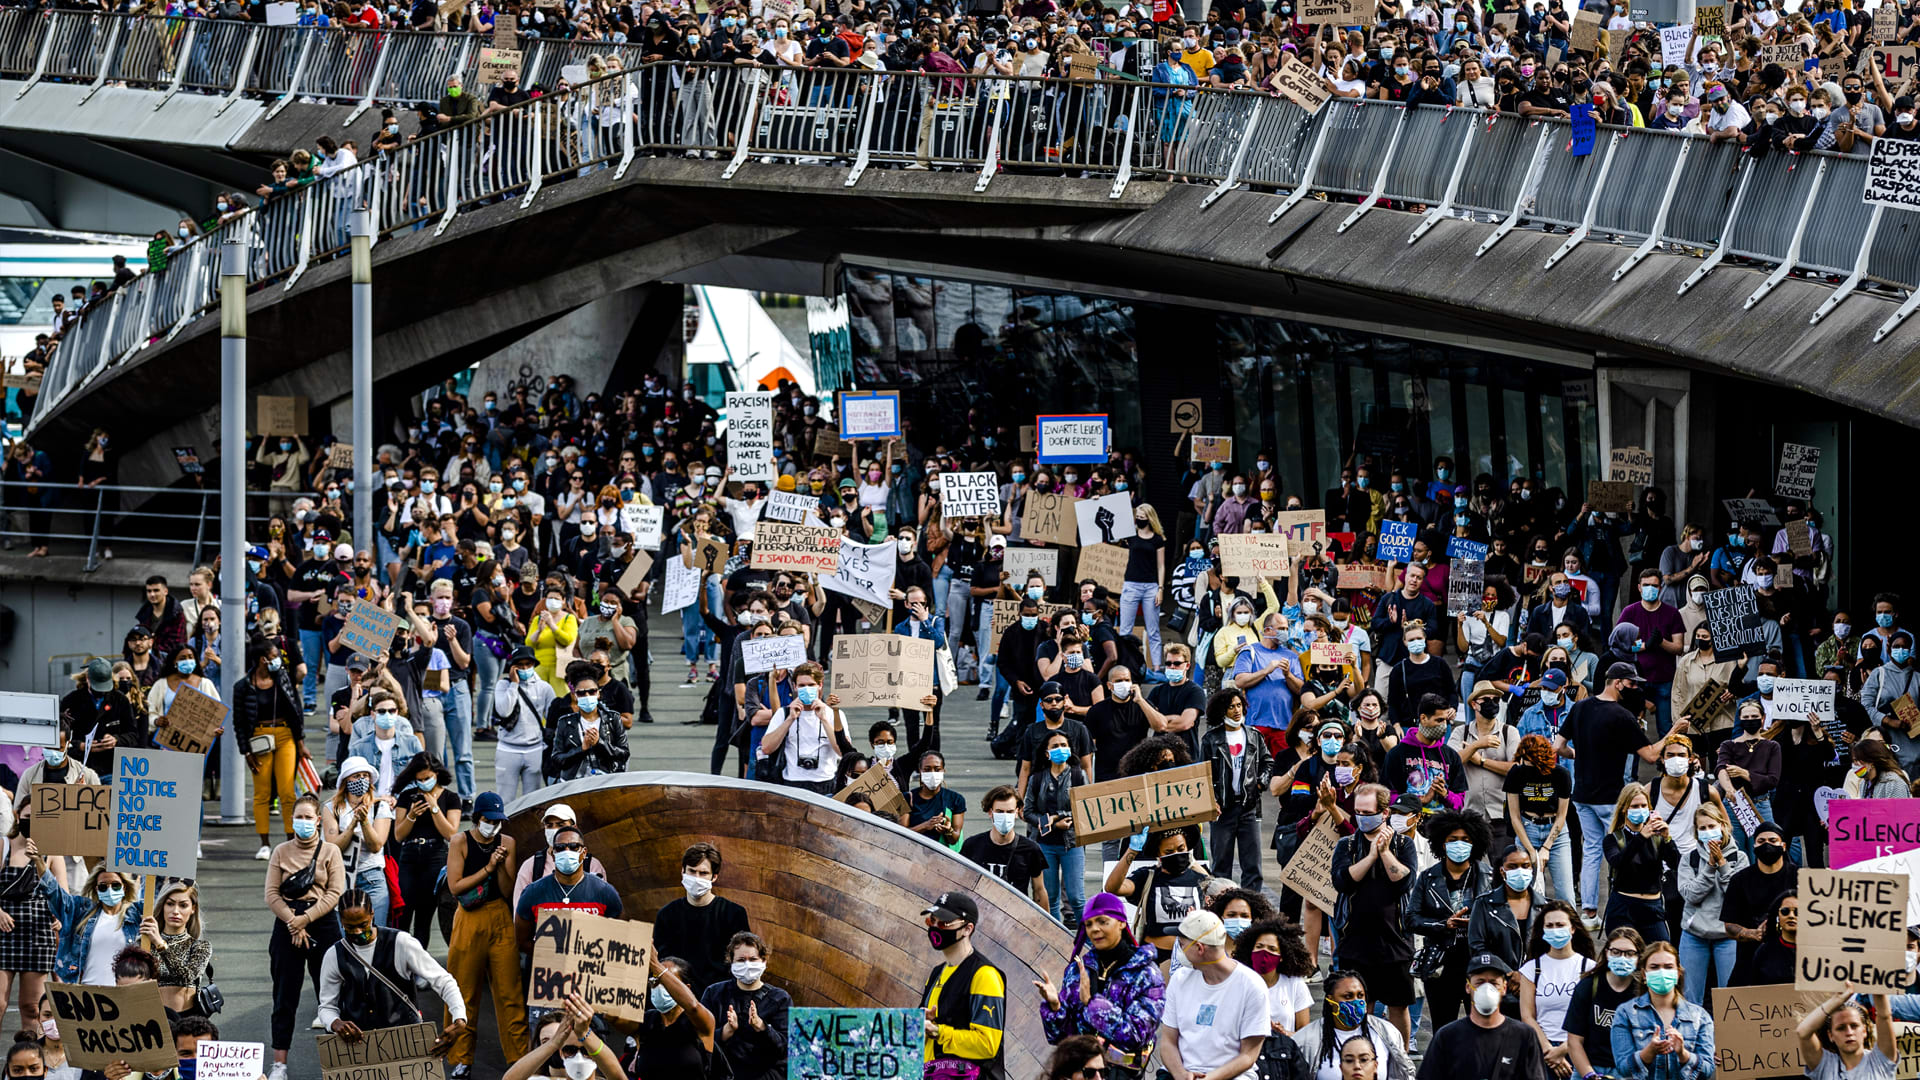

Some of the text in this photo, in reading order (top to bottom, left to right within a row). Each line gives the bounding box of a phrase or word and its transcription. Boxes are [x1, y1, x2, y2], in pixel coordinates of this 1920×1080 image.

[1698, 7, 1723, 18] BLACK
[1700, 17, 1724, 27] LIVES
[1664, 30, 1693, 42] BLACK
[1697, 26, 1726, 36] MATTER
[1763, 45, 1801, 55] NO JUSTICE
[1763, 53, 1800, 63] NO PEACE
[1874, 139, 1920, 156] RESPEC
[1870, 156, 1918, 170] BLACK
[1864, 189, 1899, 204] BLACK
[729, 396, 769, 409] RACISM
[728, 419, 769, 431] BIGGER
[1043, 423, 1103, 435] ZWARTE LEVENS
[738, 430, 761, 439] THAN
[1049, 437, 1097, 447] DOEN ERTOE
[736, 450, 762, 460] HATE
[1612, 452, 1624, 462] NO
[944, 473, 996, 488] BLACK
[1611, 469, 1651, 484] NO PEACE
[773, 492, 819, 509] BLACK LIVES
[946, 488, 996, 502] LIVES
[1032, 491, 1069, 511] PLOT
[943, 502, 999, 516] MATTER
[1728, 500, 1746, 509] NO
[770, 505, 803, 522] MATTE
[1028, 511, 1061, 535] PLAN
[1389, 523, 1409, 535] FCK
[757, 524, 838, 538] I UNDERSTAND
[1278, 522, 1324, 541] WTF
[757, 533, 842, 548] THAT I WILL NEVER
[1379, 533, 1415, 547] GOUDEN
[754, 543, 804, 552] UNDERSTAND
[805, 545, 840, 554] HOWEVER
[1381, 546, 1409, 558] KOETS
[756, 554, 836, 568] I STAND WITH YOU
[1011, 552, 1056, 564] NO JUSTICE
[1010, 568, 1024, 577] NO
[1450, 581, 1481, 595] HUMAN
[1703, 584, 1757, 608] RESPECT BLACK
[995, 600, 1002, 611] I
[1707, 601, 1759, 622] LIVES LIKE U
[1711, 615, 1744, 637] RESPECT
[1713, 625, 1765, 651] BLACK CULTURE
[837, 639, 931, 660] ENOUGH
[1311, 643, 1337, 651] BLACK
[834, 671, 930, 690] ENOUGH
[1776, 683, 1806, 694] WHITE
[1776, 701, 1831, 714] VIOLENCE
[120, 755, 149, 777] NO
[118, 778, 177, 798] JUSTICE
[37, 787, 112, 814] BLAC
[118, 796, 145, 813] NO
[1082, 780, 1205, 831] Black Lives
[117, 813, 162, 831] PEACE
[116, 831, 142, 847] NO
[114, 847, 168, 868] POLICE
[1310, 843, 1332, 862] MITCH
[1295, 859, 1324, 882] ZWARTE
[1808, 876, 1893, 905] WHiTE
[1806, 900, 1902, 932] SiLENCE
[533, 914, 572, 956] All
[573, 930, 604, 960] lives
[578, 960, 607, 977] until
[585, 974, 615, 1005] lives
[50, 990, 120, 1022] END
[1723, 995, 1807, 1022] ASIANS
[76, 1019, 164, 1053] RACiSM
[795, 1012, 917, 1050] WE ALL
[1759, 1024, 1790, 1039] For
[199, 1043, 260, 1063] InjusticE
[319, 1024, 438, 1068] THEY KILLED
[203, 1061, 245, 1072] Anywhere
[822, 1047, 899, 1079] BLEED
[1720, 1048, 1790, 1072] BLACK
[198, 1071, 207, 1079] IS
[217, 1071, 240, 1079] threat
[399, 1061, 441, 1080] FOR
